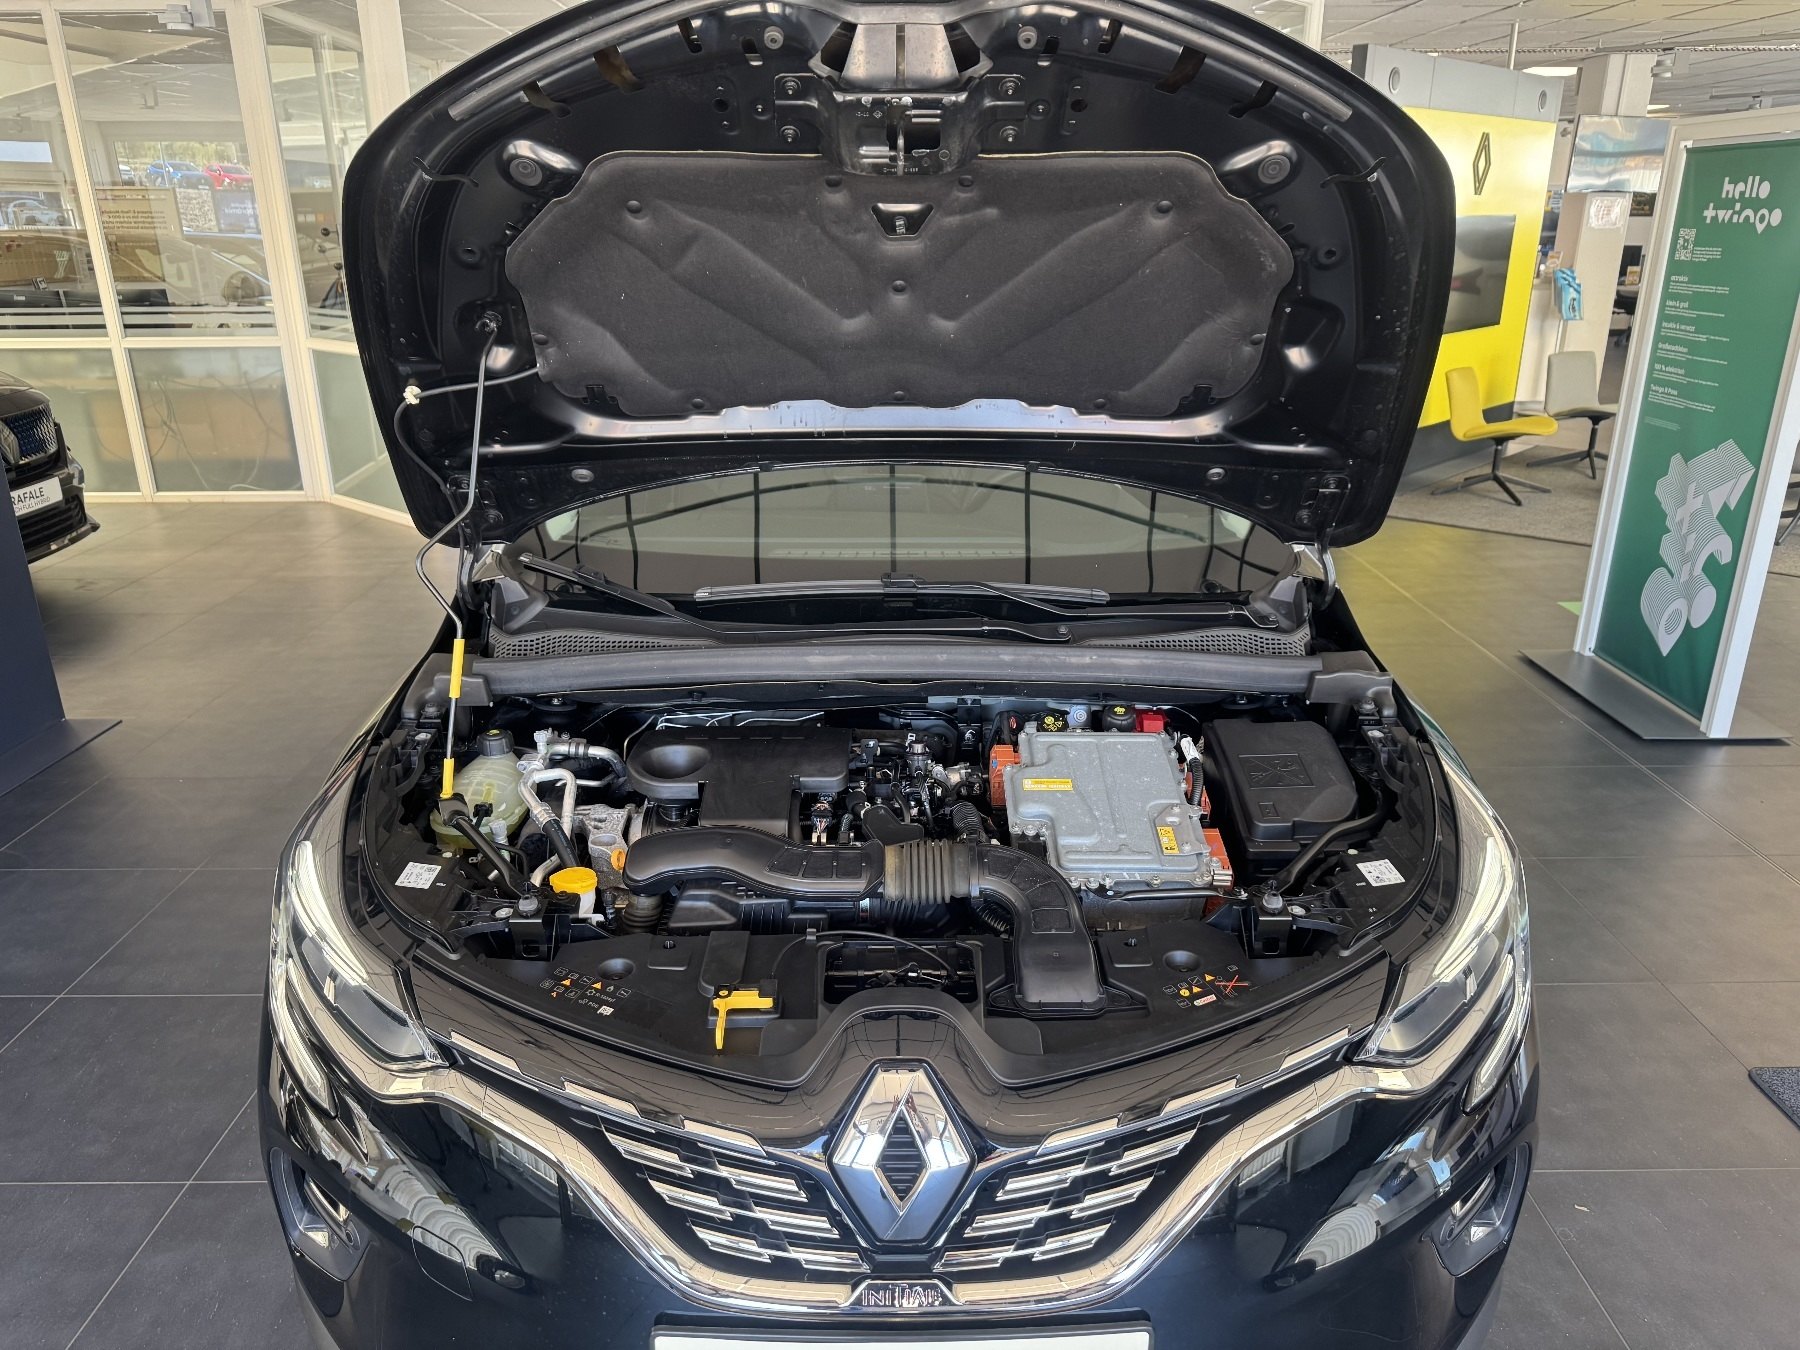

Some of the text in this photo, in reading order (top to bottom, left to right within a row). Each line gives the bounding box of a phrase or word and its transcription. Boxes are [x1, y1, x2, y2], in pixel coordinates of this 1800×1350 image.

[1722, 175, 1770, 200] hello
[1703, 202, 1783, 235] twingo
[11, 487, 44, 505] RAFALE
